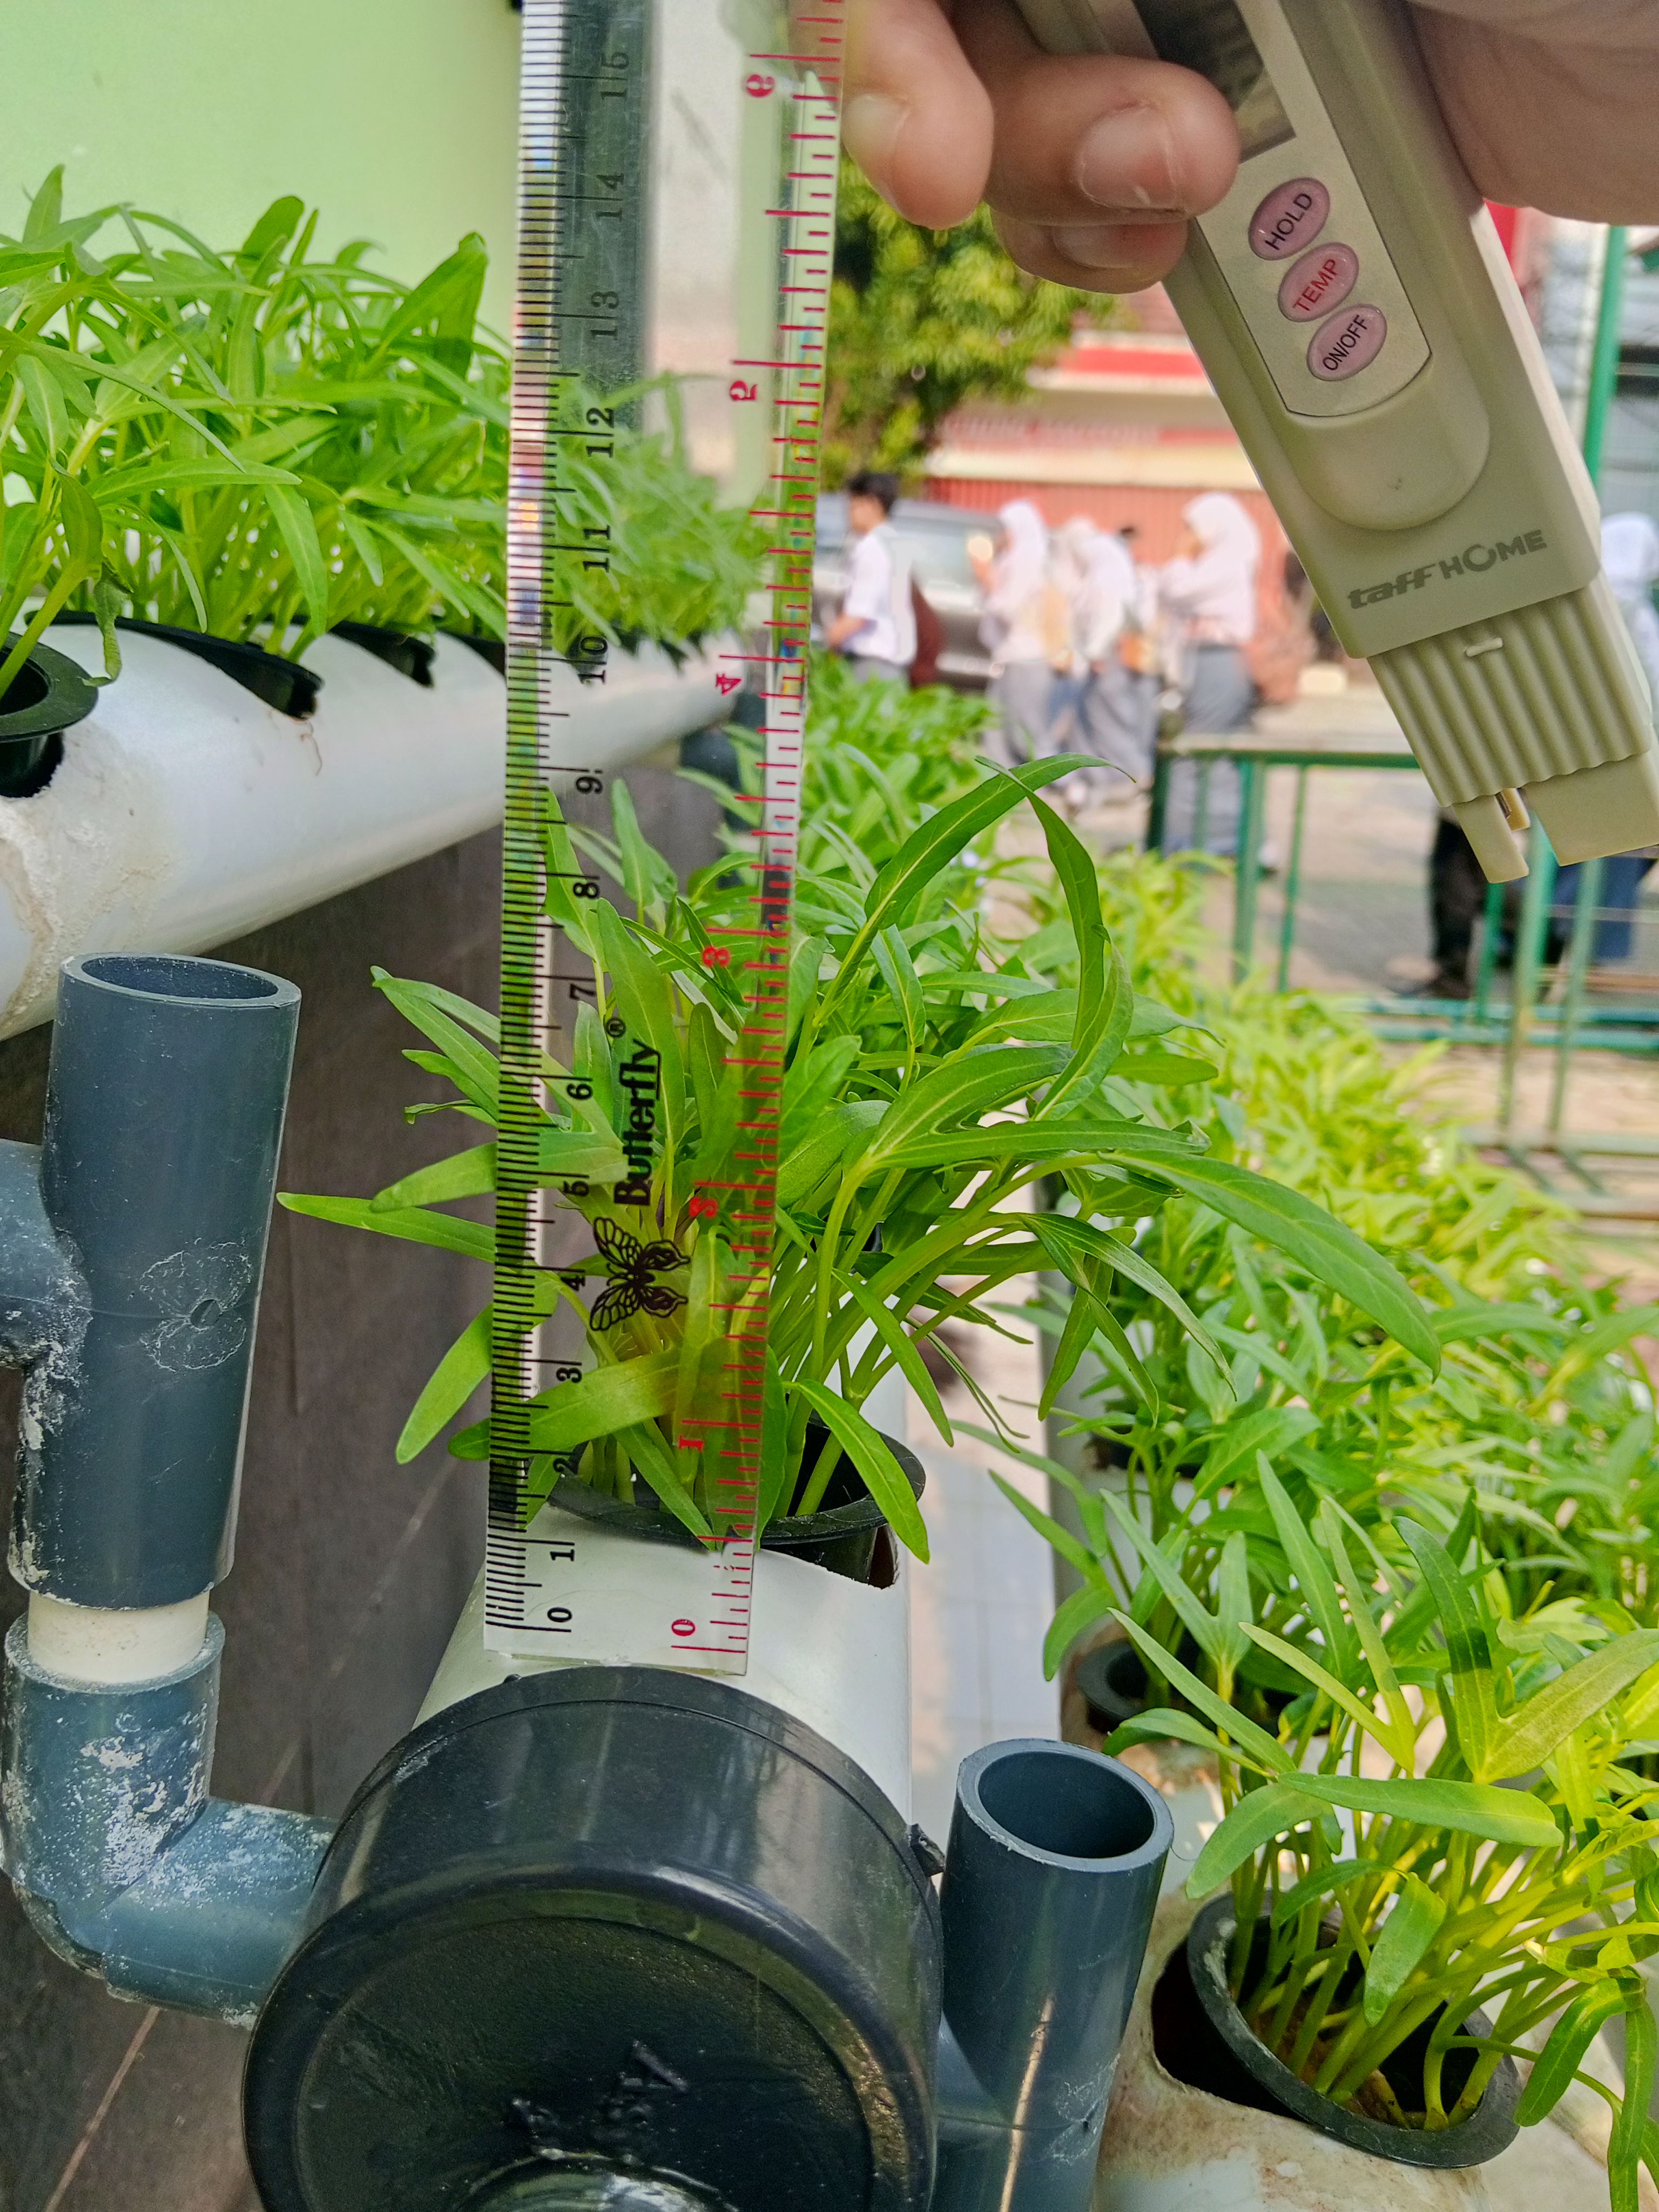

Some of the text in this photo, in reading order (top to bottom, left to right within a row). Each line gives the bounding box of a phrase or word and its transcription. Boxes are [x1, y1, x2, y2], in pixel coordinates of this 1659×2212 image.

[601, 51, 630, 101] 15
[595, 172, 624, 222] 14
[1265, 193, 1312, 251] HOLD
[1293, 258, 1338, 313] TEMP
[590, 291, 619, 341] 13
[1322, 314, 1367, 371] ON/OFF
[586, 407, 615, 458] 12
[583, 525, 611, 574] 11
[579, 636, 608, 685] 10
[576, 775, 604, 794] 9
[572, 881, 600, 899] 8
[569, 983, 597, 1001] 7
[567, 1082, 593, 1100] 6
[613, 1038, 661, 1205] Butterfly
[563, 1181, 590, 1197] 5
[561, 1276, 586, 1291] 4
[556, 1367, 583, 1384] 3
[552, 1457, 577, 1475] 2
[550, 1548, 575, 1562] 1
[547, 1606, 572, 1623] 0
